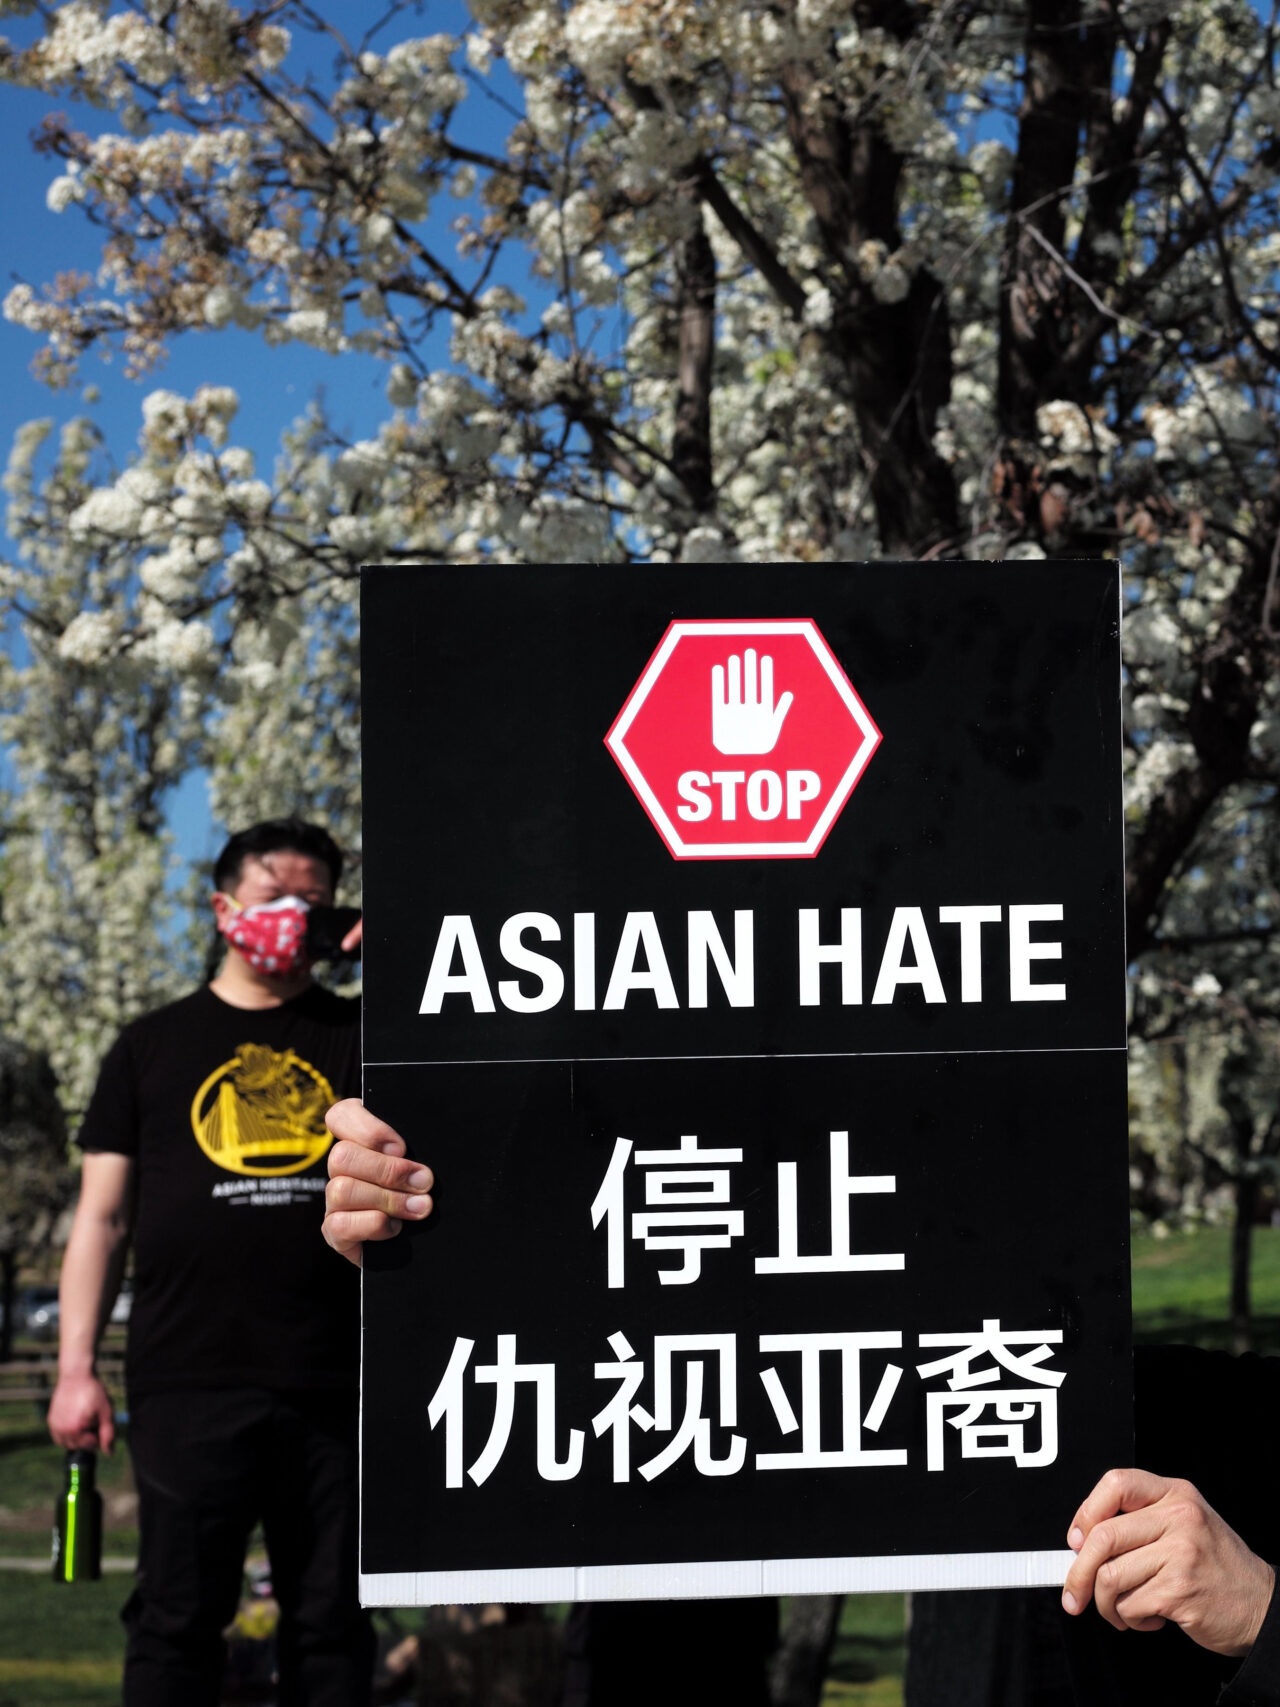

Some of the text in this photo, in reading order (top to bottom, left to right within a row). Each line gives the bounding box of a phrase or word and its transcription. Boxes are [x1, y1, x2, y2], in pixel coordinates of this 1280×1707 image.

[677, 769, 822, 822] STOP
[418, 903, 1067, 1015] ASIAN HATE
[212, 1180, 258, 1198] ASIAN
[590, 1131, 906, 1289] 停止
[427, 1318, 1068, 1489] 仇视亚裔
